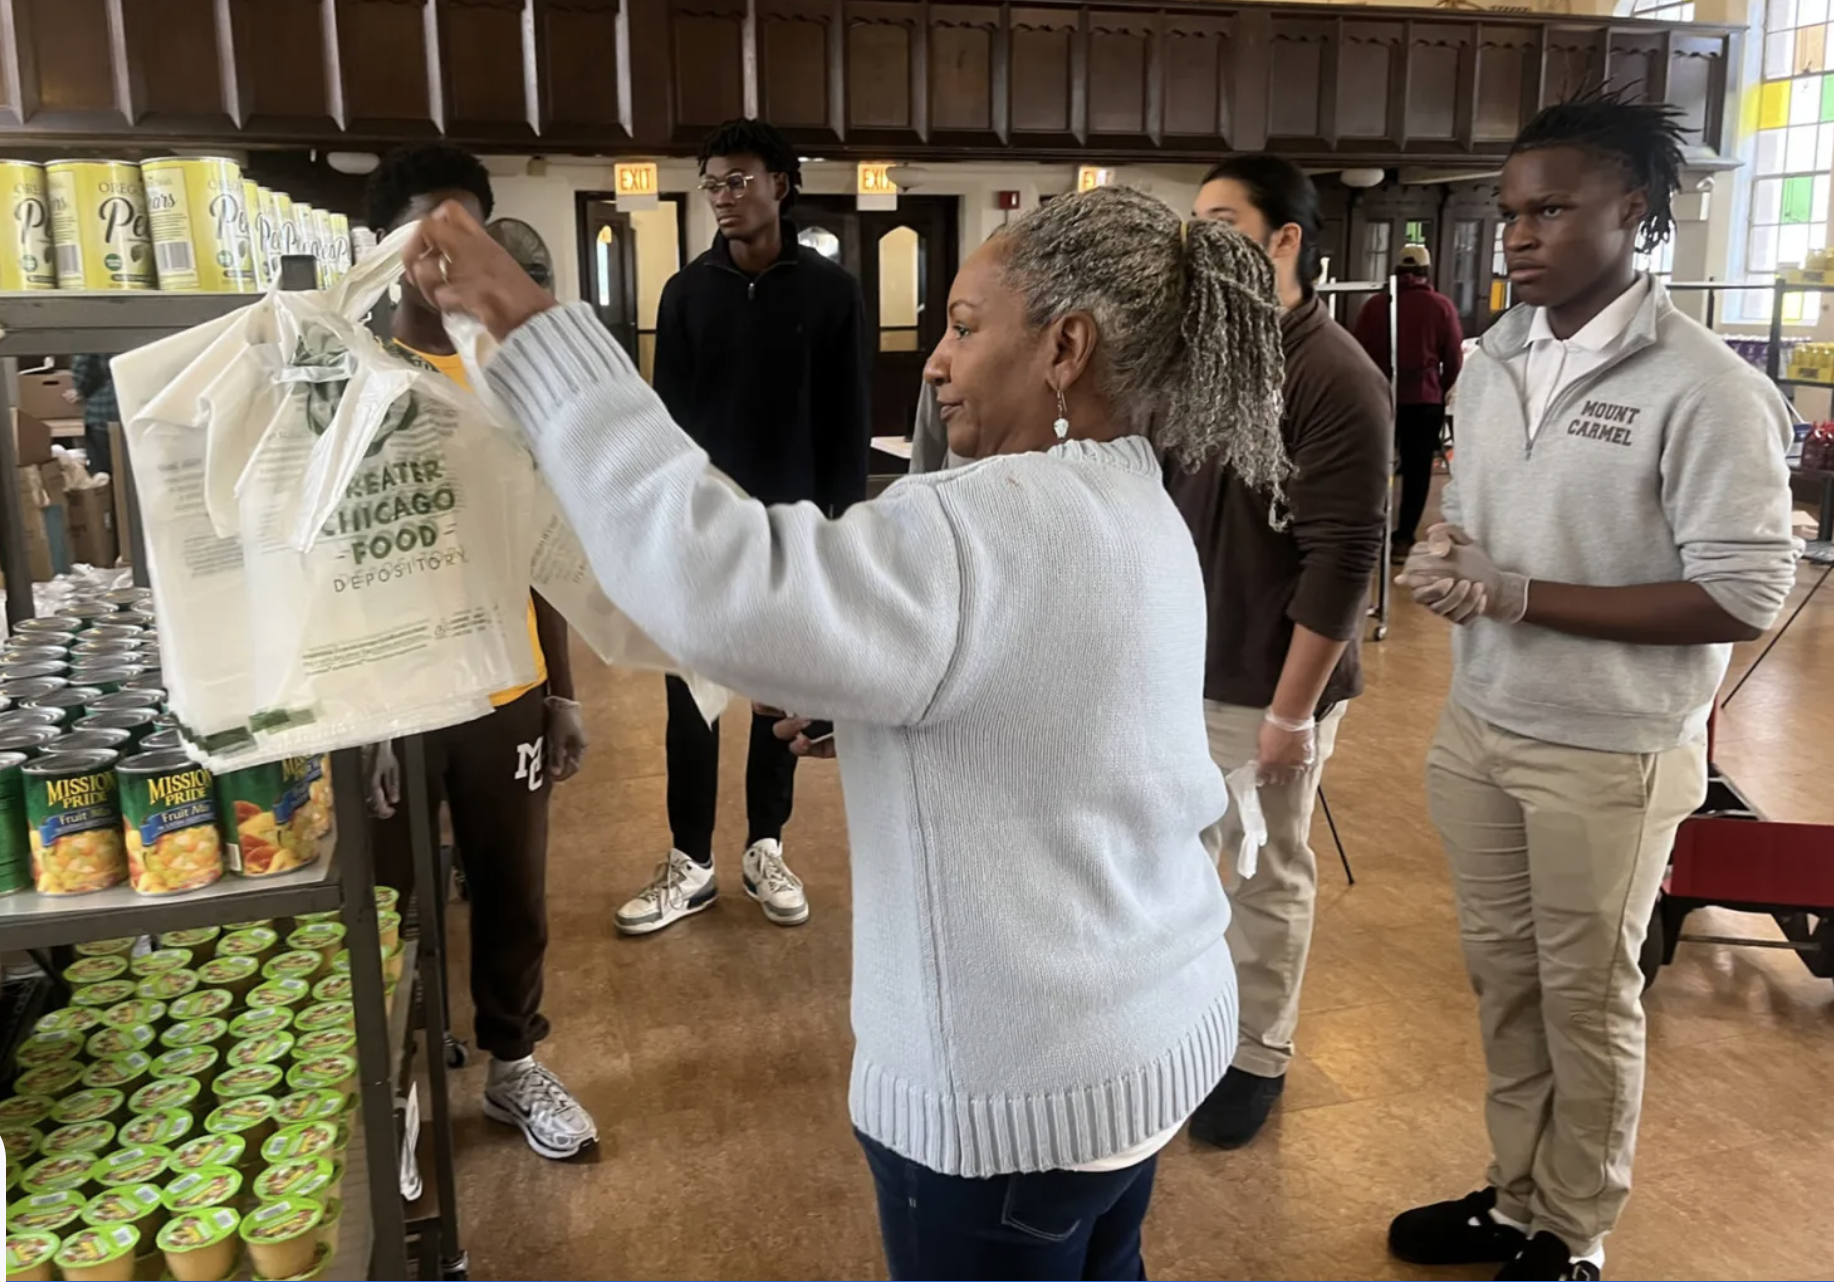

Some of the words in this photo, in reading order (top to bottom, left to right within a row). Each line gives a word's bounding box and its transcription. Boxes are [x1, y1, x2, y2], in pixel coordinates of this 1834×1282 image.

[620, 168, 650, 190] EXIT
[98, 196, 148, 244] Pe
[1581, 400, 1641, 425] MOUNT
[1567, 419, 1632, 447] CARMEL
[345, 460, 443, 498] REATER
[352, 523, 438, 565] FOOD
[333, 546, 469, 593] DEPOSITORY
[63, 792, 107, 809] PRIDE
[165, 787, 207, 806] PRIDE
[60, 812, 87, 825] Fruit
[162, 808, 188, 823] Fruit
